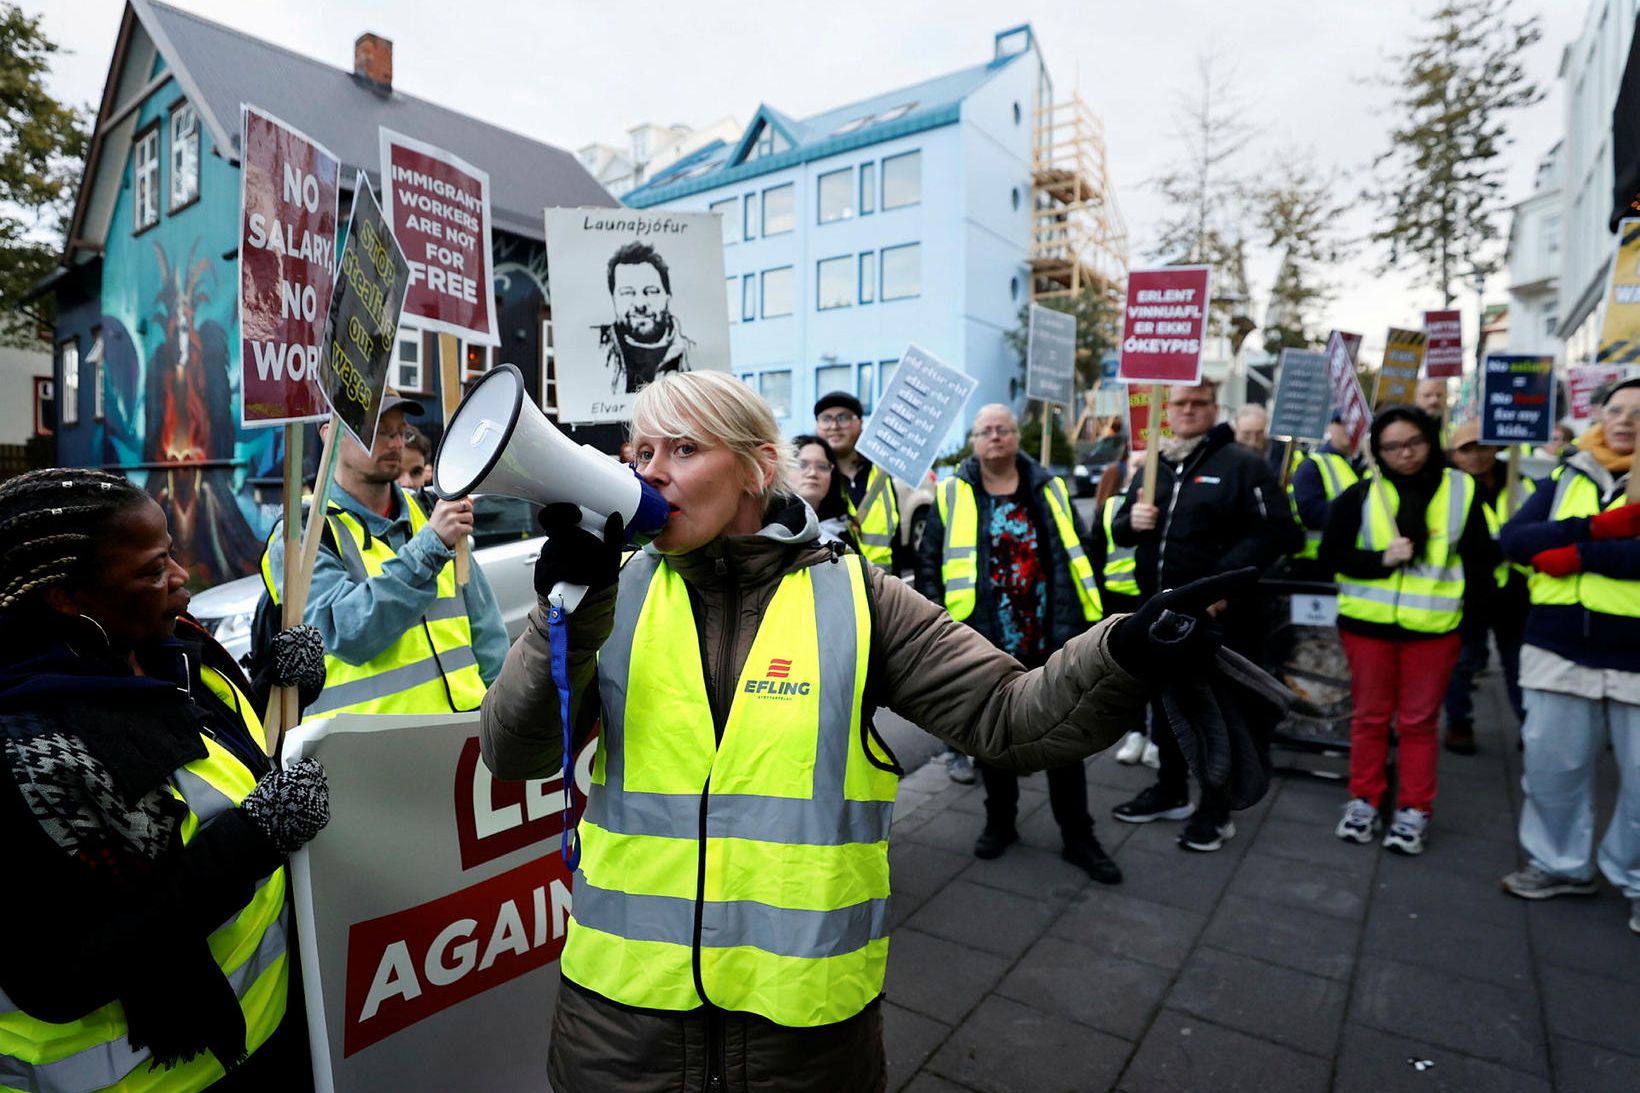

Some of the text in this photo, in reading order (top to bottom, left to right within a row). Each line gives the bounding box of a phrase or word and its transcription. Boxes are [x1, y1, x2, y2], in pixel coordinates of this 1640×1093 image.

[283, 161, 319, 213] NO
[392, 165, 483, 213] IMMIGRANT
[398, 188, 479, 233] WORKERS
[583, 216, 689, 236] Launaþjófur
[247, 213, 333, 276] SALARY,
[406, 214, 476, 250] ARE NOT
[361, 219, 395, 288] STOP
[426, 242, 464, 271] FOR
[281, 279, 317, 323] NO
[407, 259, 478, 304] FREE
[1137, 289, 1196, 303] ERLENT
[1127, 305, 1202, 319] VINNUAFL
[1134, 321, 1192, 335] ER EKKI
[349, 316, 373, 362] our
[1123, 335, 1200, 354] ÓKEYPIS
[251, 340, 321, 382] WOR
[332, 341, 372, 411] wages
[591, 401, 625, 414] Elvar
[744, 680, 810, 695] EFLING
